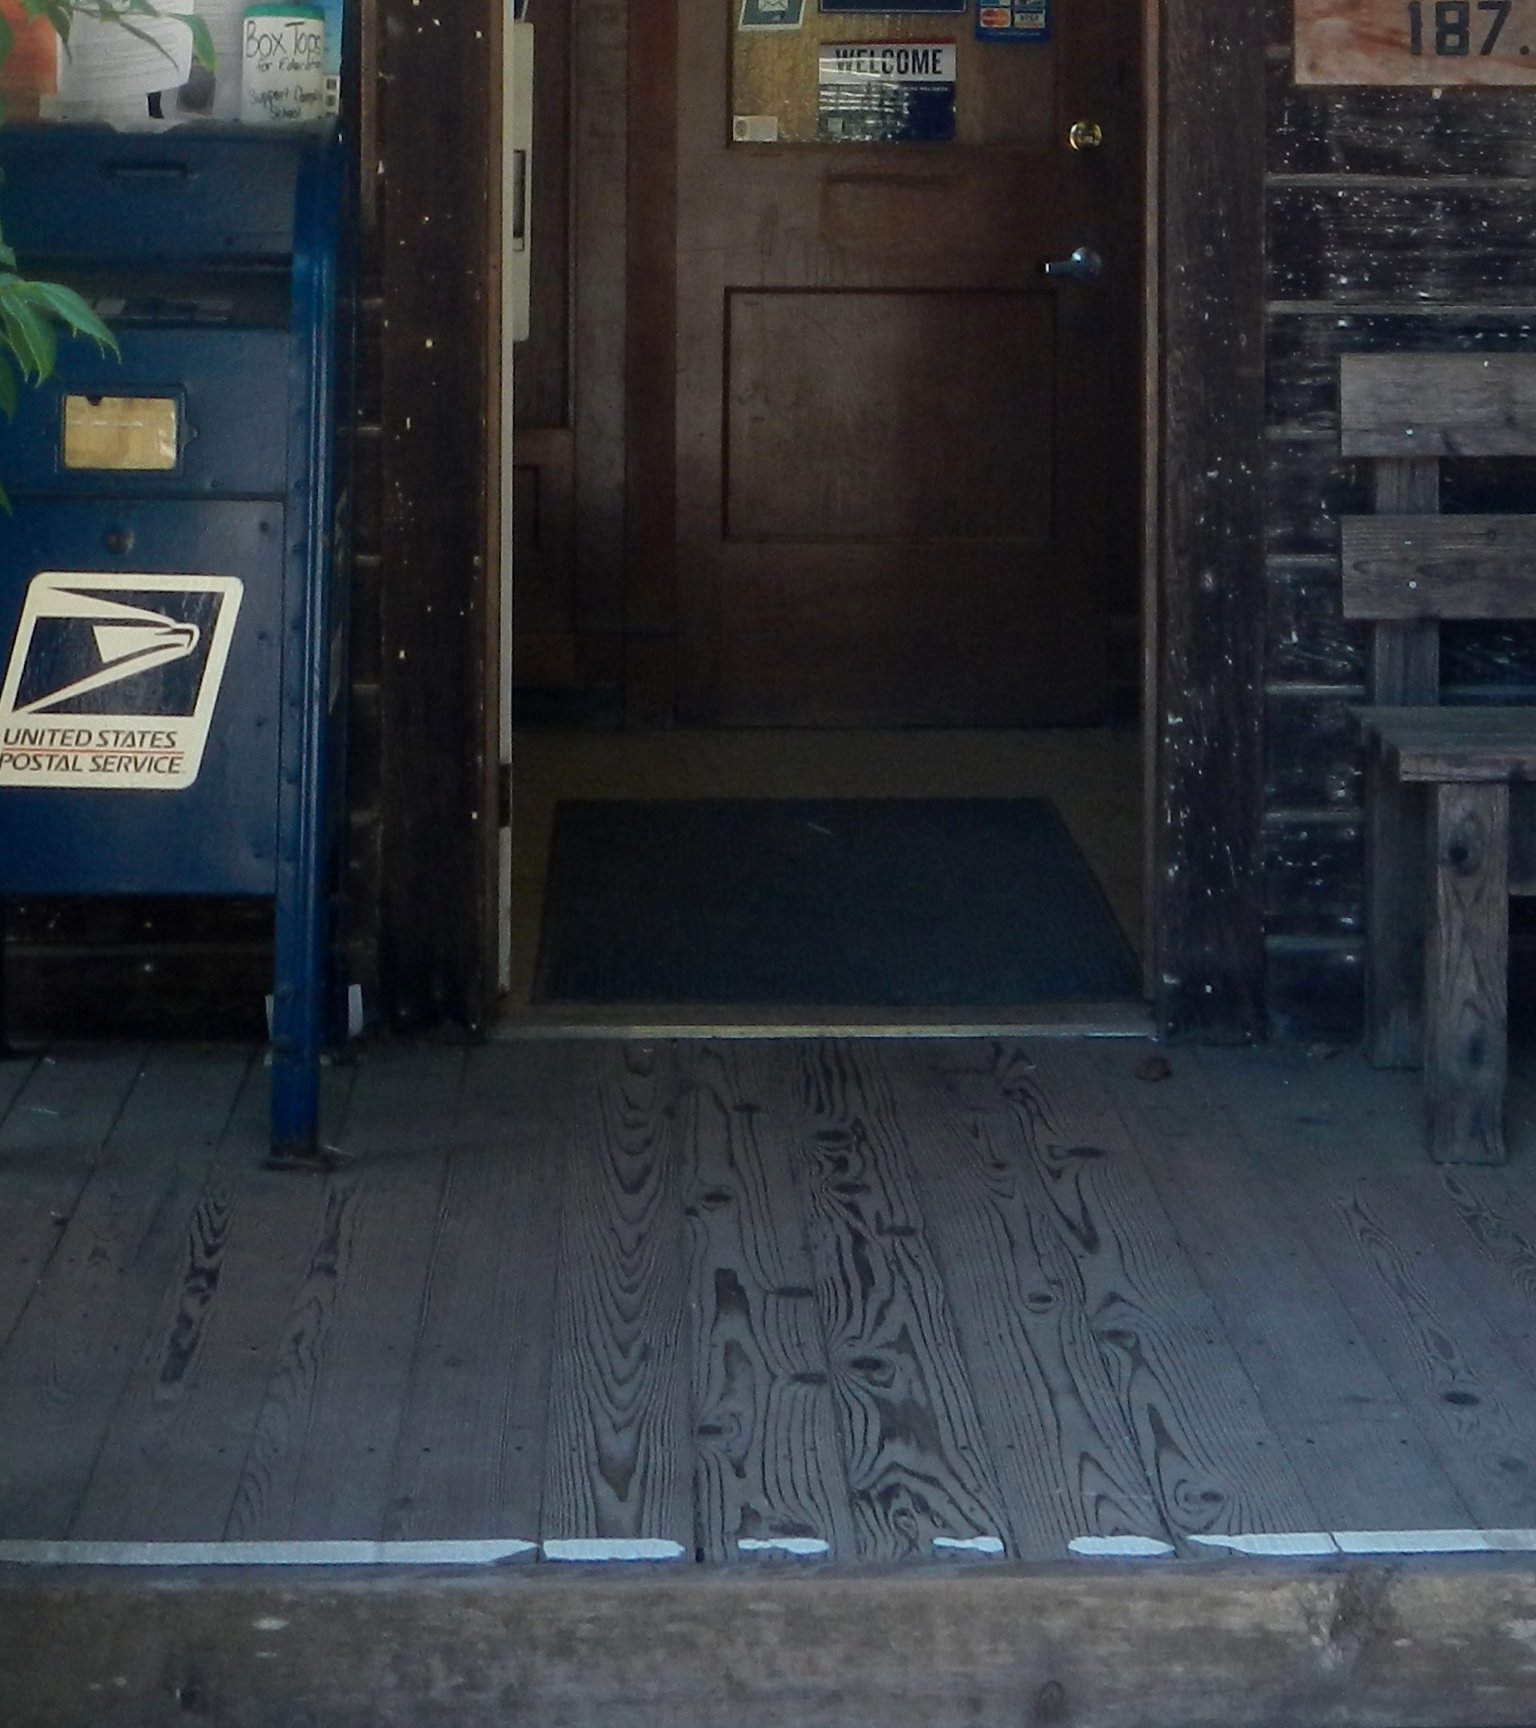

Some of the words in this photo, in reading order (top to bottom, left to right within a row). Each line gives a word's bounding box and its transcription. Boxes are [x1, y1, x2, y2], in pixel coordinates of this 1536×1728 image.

[246, 20, 286, 58] Box
[835, 48, 943, 75] WELCOME
[3, 728, 93, 747] UNITED
[95, 729, 178, 748] STATES
[88, 754, 185, 774] SERVICE
